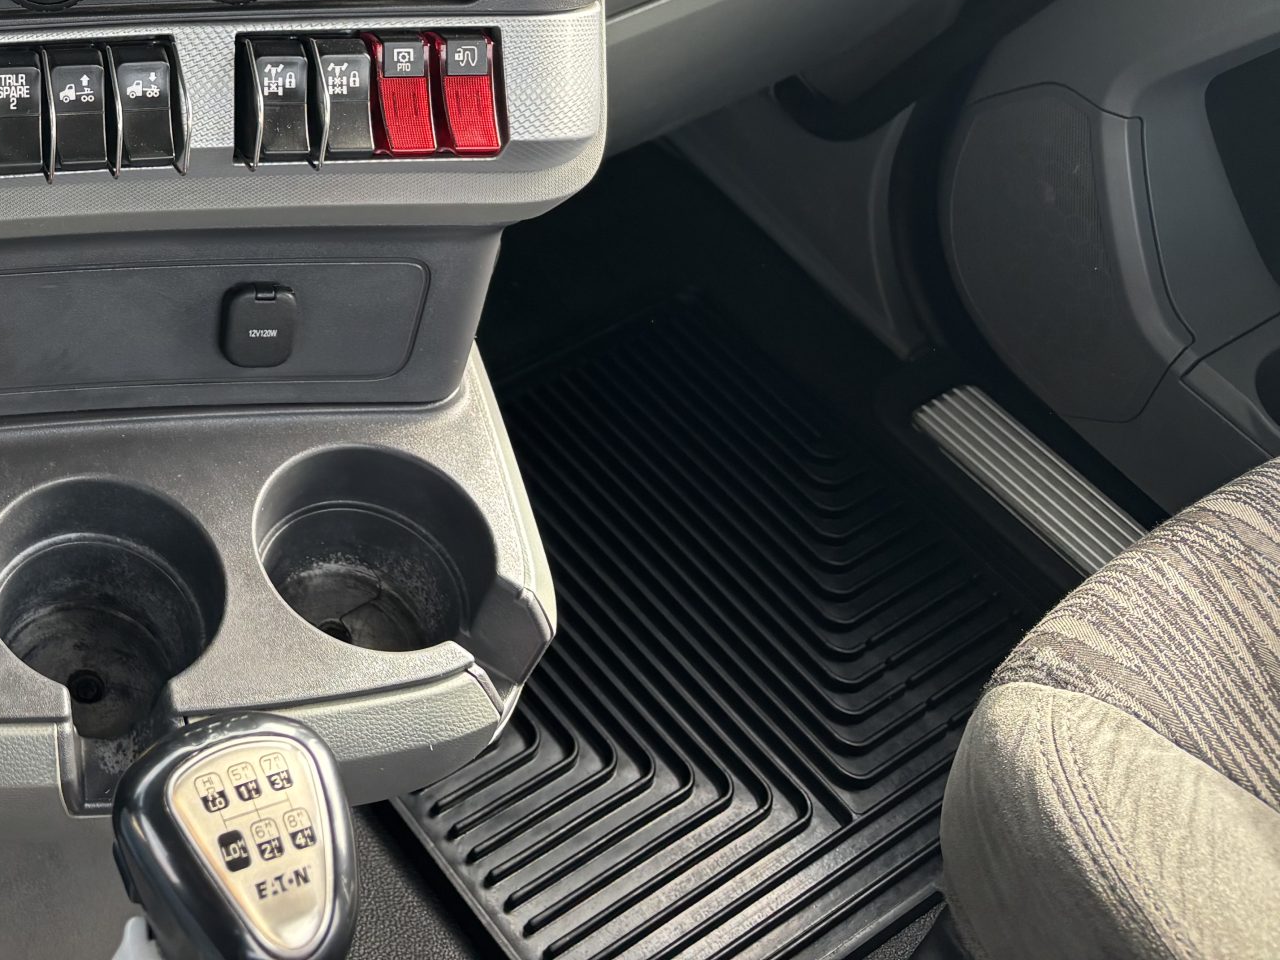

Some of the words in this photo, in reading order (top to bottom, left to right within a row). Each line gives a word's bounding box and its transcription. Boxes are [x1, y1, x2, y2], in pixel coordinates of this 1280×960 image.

[396, 62, 411, 72] PTO
[0, 74, 26, 86] TRLR
[9, 98, 17, 110] 2
[208, 798, 225, 811] LO
